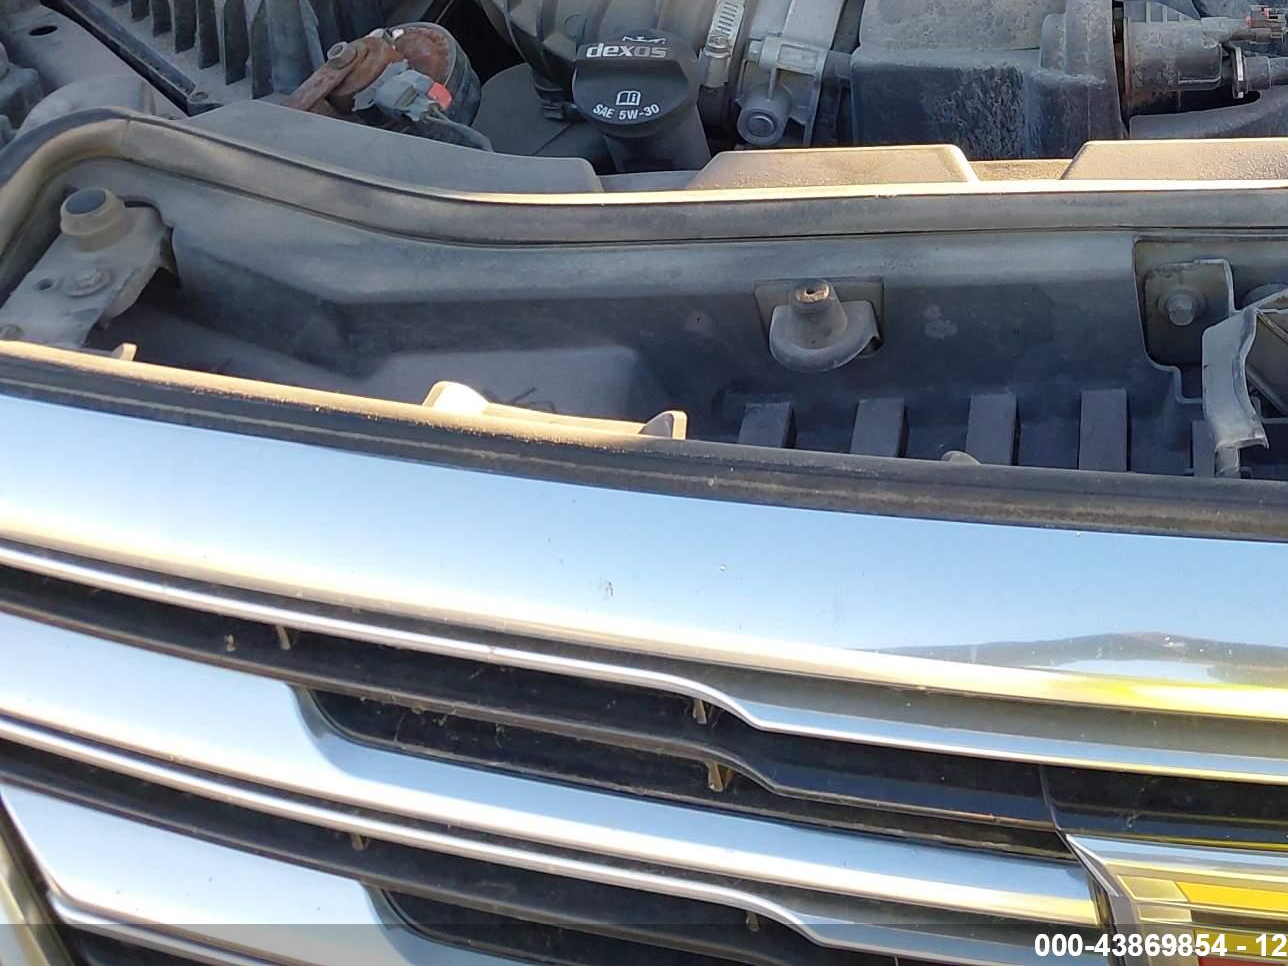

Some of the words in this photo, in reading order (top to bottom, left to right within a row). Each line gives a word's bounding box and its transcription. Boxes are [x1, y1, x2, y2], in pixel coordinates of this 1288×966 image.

[586, 43, 668, 58] dexos
[593, 104, 615, 119] SAE
[618, 104, 660, 120] 5W-30
